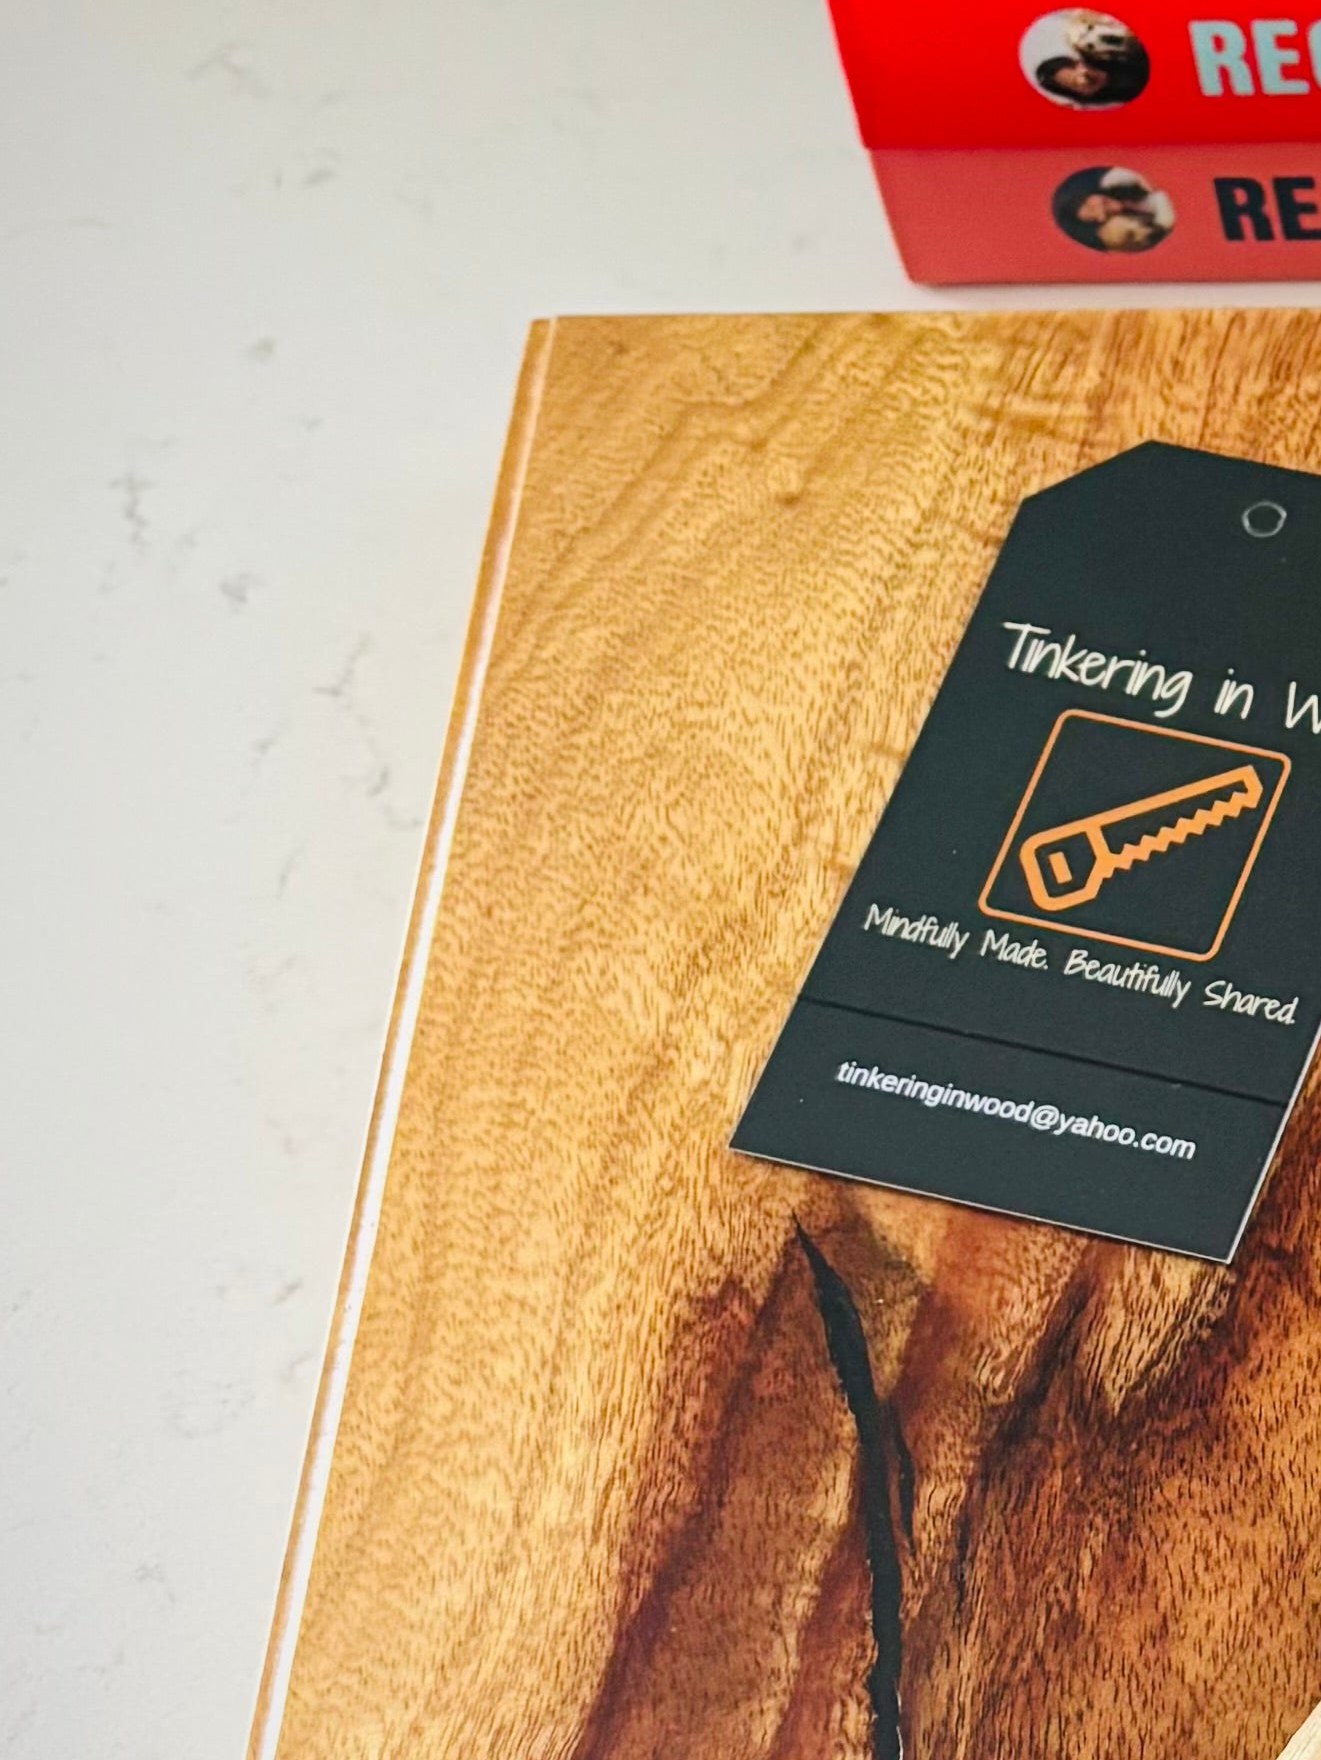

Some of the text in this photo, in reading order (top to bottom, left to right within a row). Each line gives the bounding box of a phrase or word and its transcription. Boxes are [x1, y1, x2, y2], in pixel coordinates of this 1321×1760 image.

[1003, 622, 1194, 718] Tinkering
[1214, 668, 1254, 719] in
[863, 903, 1300, 1026] Mindfully Made. Beautifully Shared.
[836, 1060, 1197, 1161] tinkeringinwood@yahoo.com
